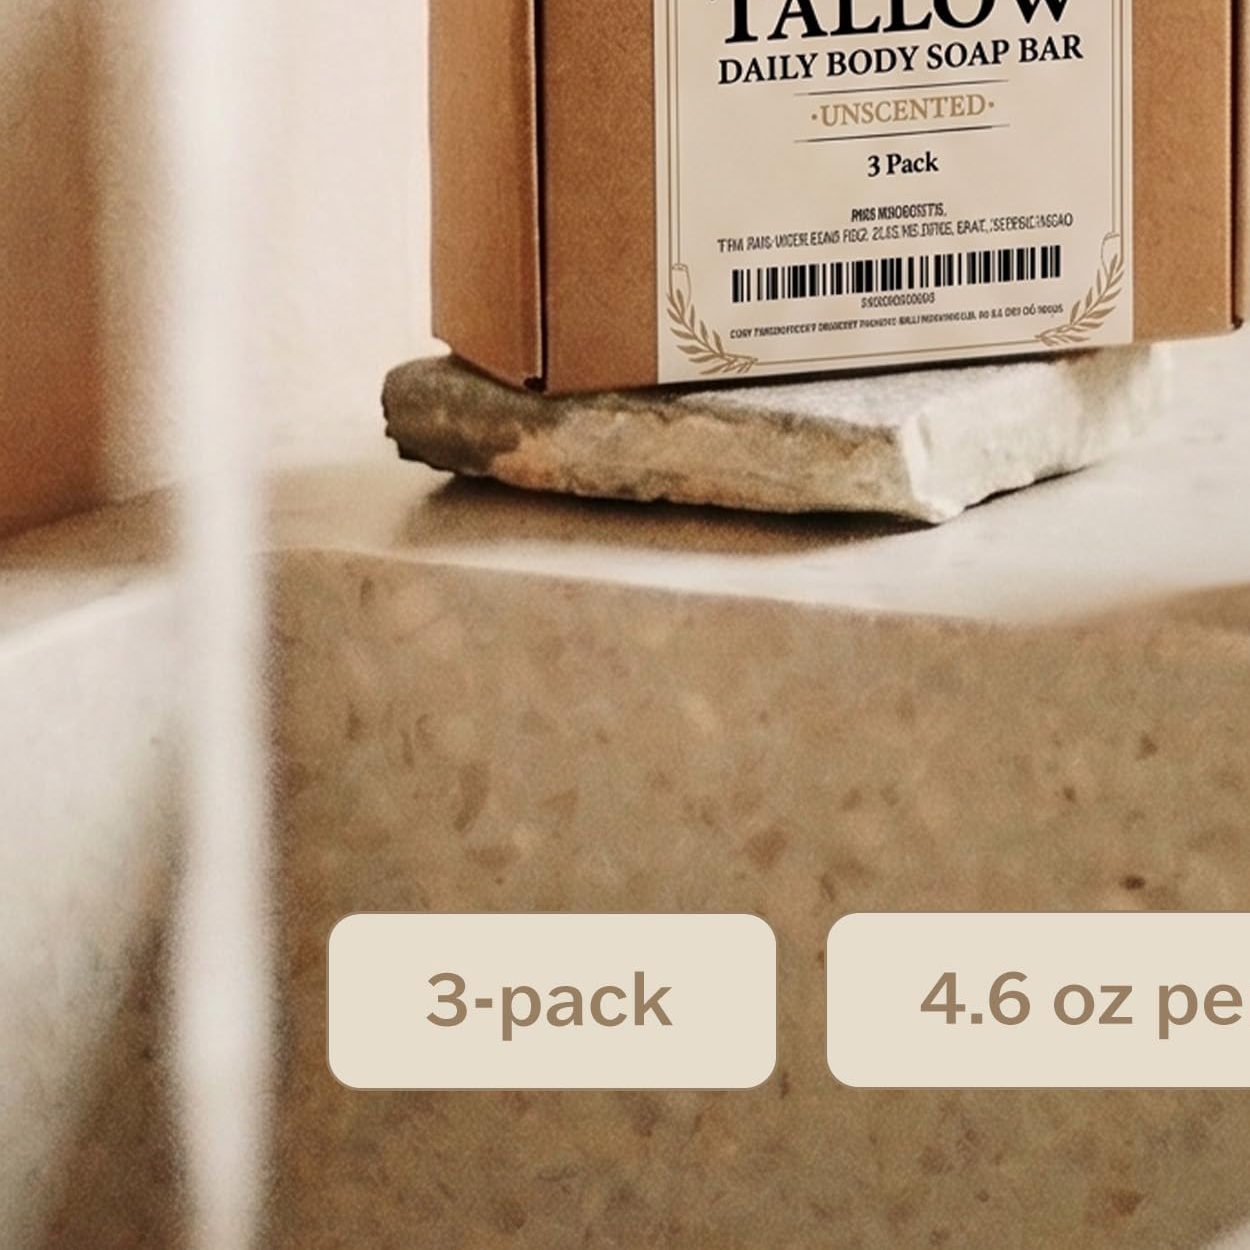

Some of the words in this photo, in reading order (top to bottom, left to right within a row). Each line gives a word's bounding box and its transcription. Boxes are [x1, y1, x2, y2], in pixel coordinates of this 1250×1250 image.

[718, 53, 819, 85] DAILY
[826, 45, 920, 78] BODY
[927, 39, 1010, 69] SOAP
[1018, 33, 1084, 64] BAR
[867, 155, 881, 177] 3
[887, 151, 940, 174] Pack
